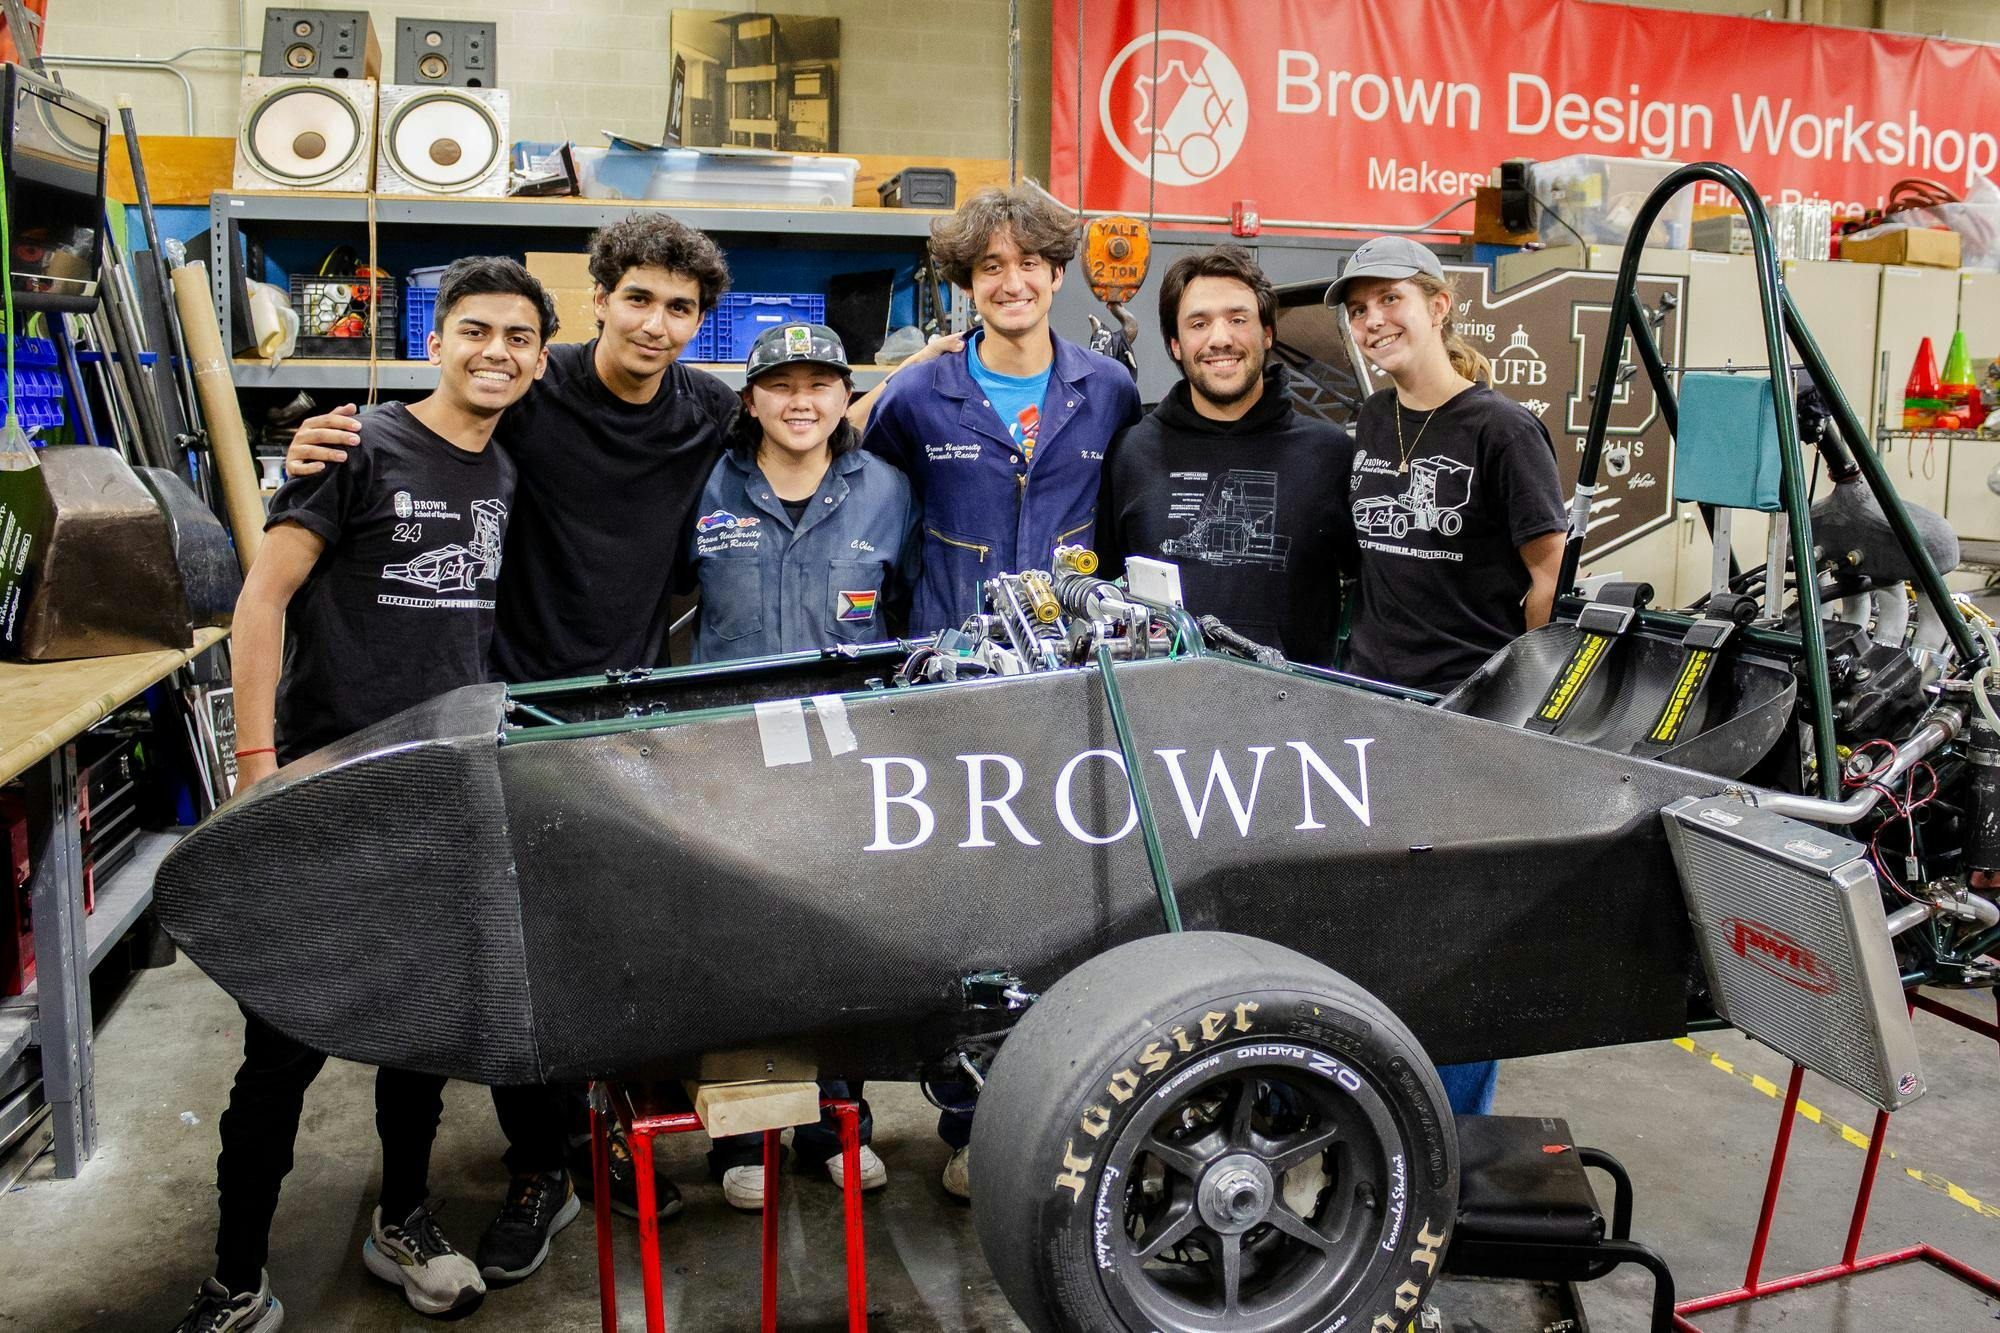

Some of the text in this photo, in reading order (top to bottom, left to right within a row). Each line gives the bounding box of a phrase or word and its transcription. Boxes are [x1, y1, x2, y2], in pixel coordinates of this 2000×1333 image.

[1276, 49, 1998, 188] Brown Design Workshop
[1368, 156, 1491, 196] Makers
[1700, 182, 1772, 208] Flr
[1099, 223, 1139, 236] YALE
[1093, 261, 1138, 278] 2 TON
[1458, 299, 1472, 315] of
[1452, 319, 1496, 343] ering
[1489, 358, 1547, 385] UFB
[945, 443, 981, 453] University
[954, 450, 979, 461] Racing
[413, 500, 447, 511] BROWN
[415, 510, 431, 518] School
[392, 523, 422, 542] 24
[697, 530, 761, 545] Brown University
[698, 539, 759, 555] Formula Racing
[1367, 541, 1418, 557] FORMULA
[378, 595, 435, 608] BROWN
[861, 738, 1375, 852] BROWN
[1237, 1047, 1305, 1059] RACING
[1055, 1001, 1260, 1203] Hoosier
